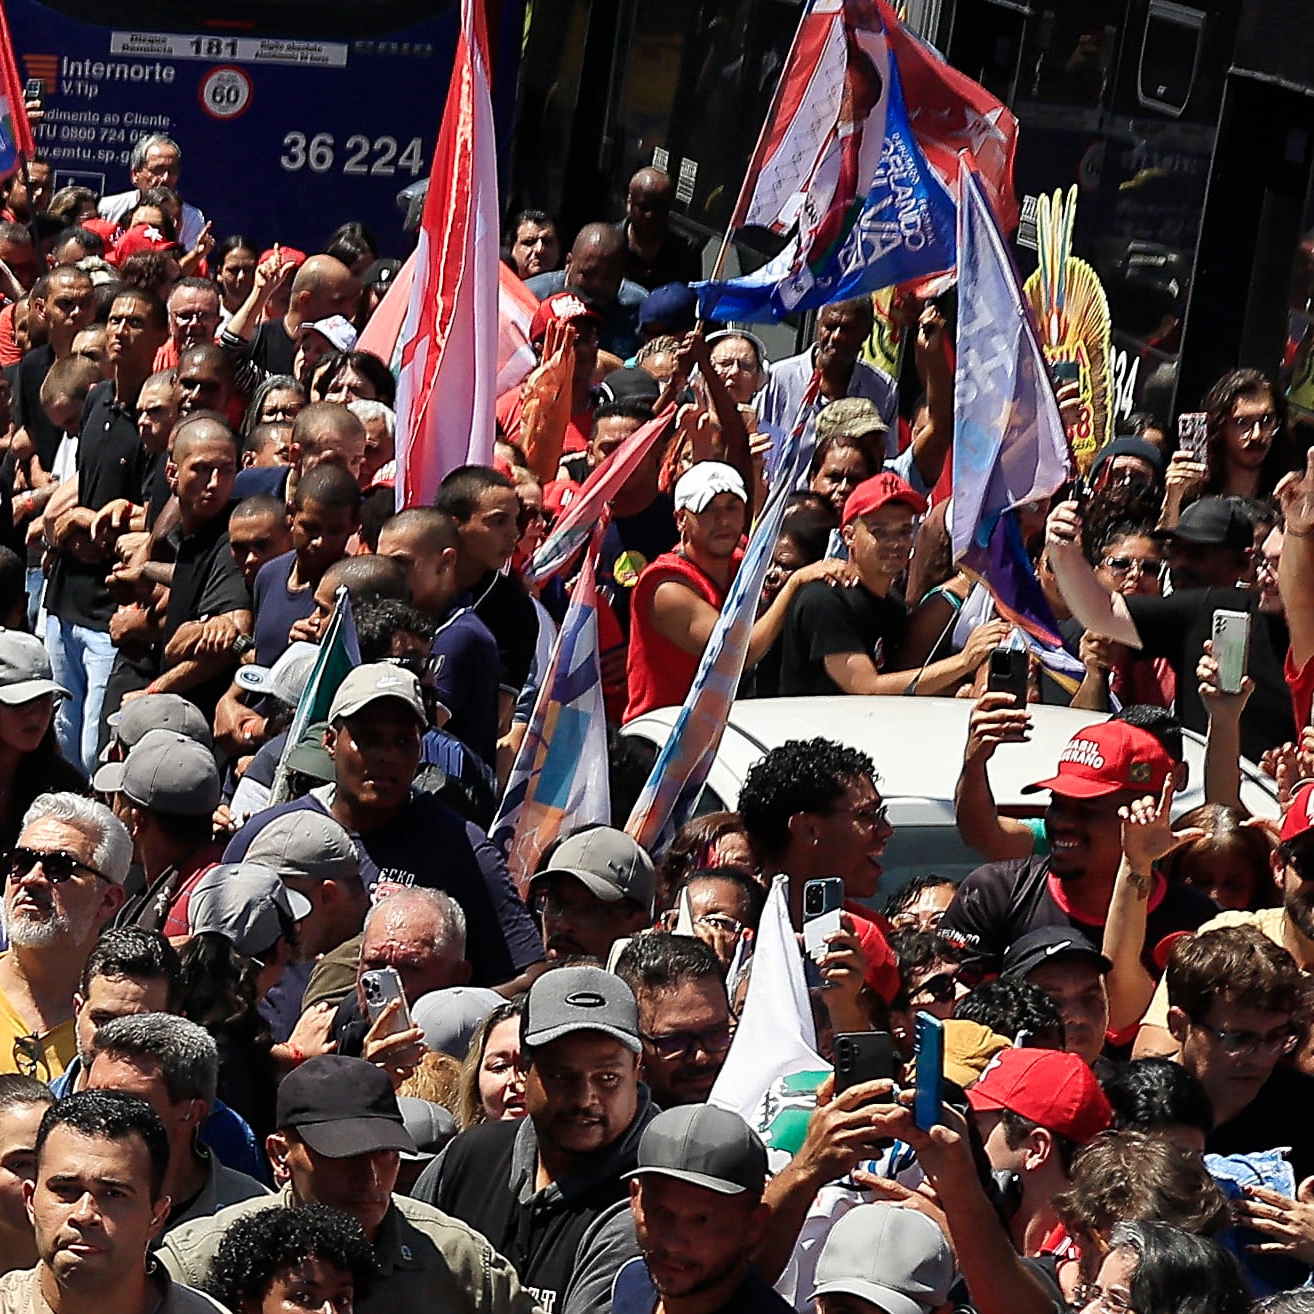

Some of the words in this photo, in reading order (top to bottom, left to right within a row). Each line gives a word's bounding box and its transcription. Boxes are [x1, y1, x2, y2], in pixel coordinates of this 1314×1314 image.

[190, 37, 239, 58] 181
[62, 55, 176, 82] Internorte
[211, 86, 240, 105] 60
[104, 113, 120, 123] ao
[124, 112, 170, 126] Cliente
[99, 127, 125, 142] 724
[281, 130, 334, 172] 36
[343, 133, 424, 176] 224
[378, 868, 415, 888] ECKO
